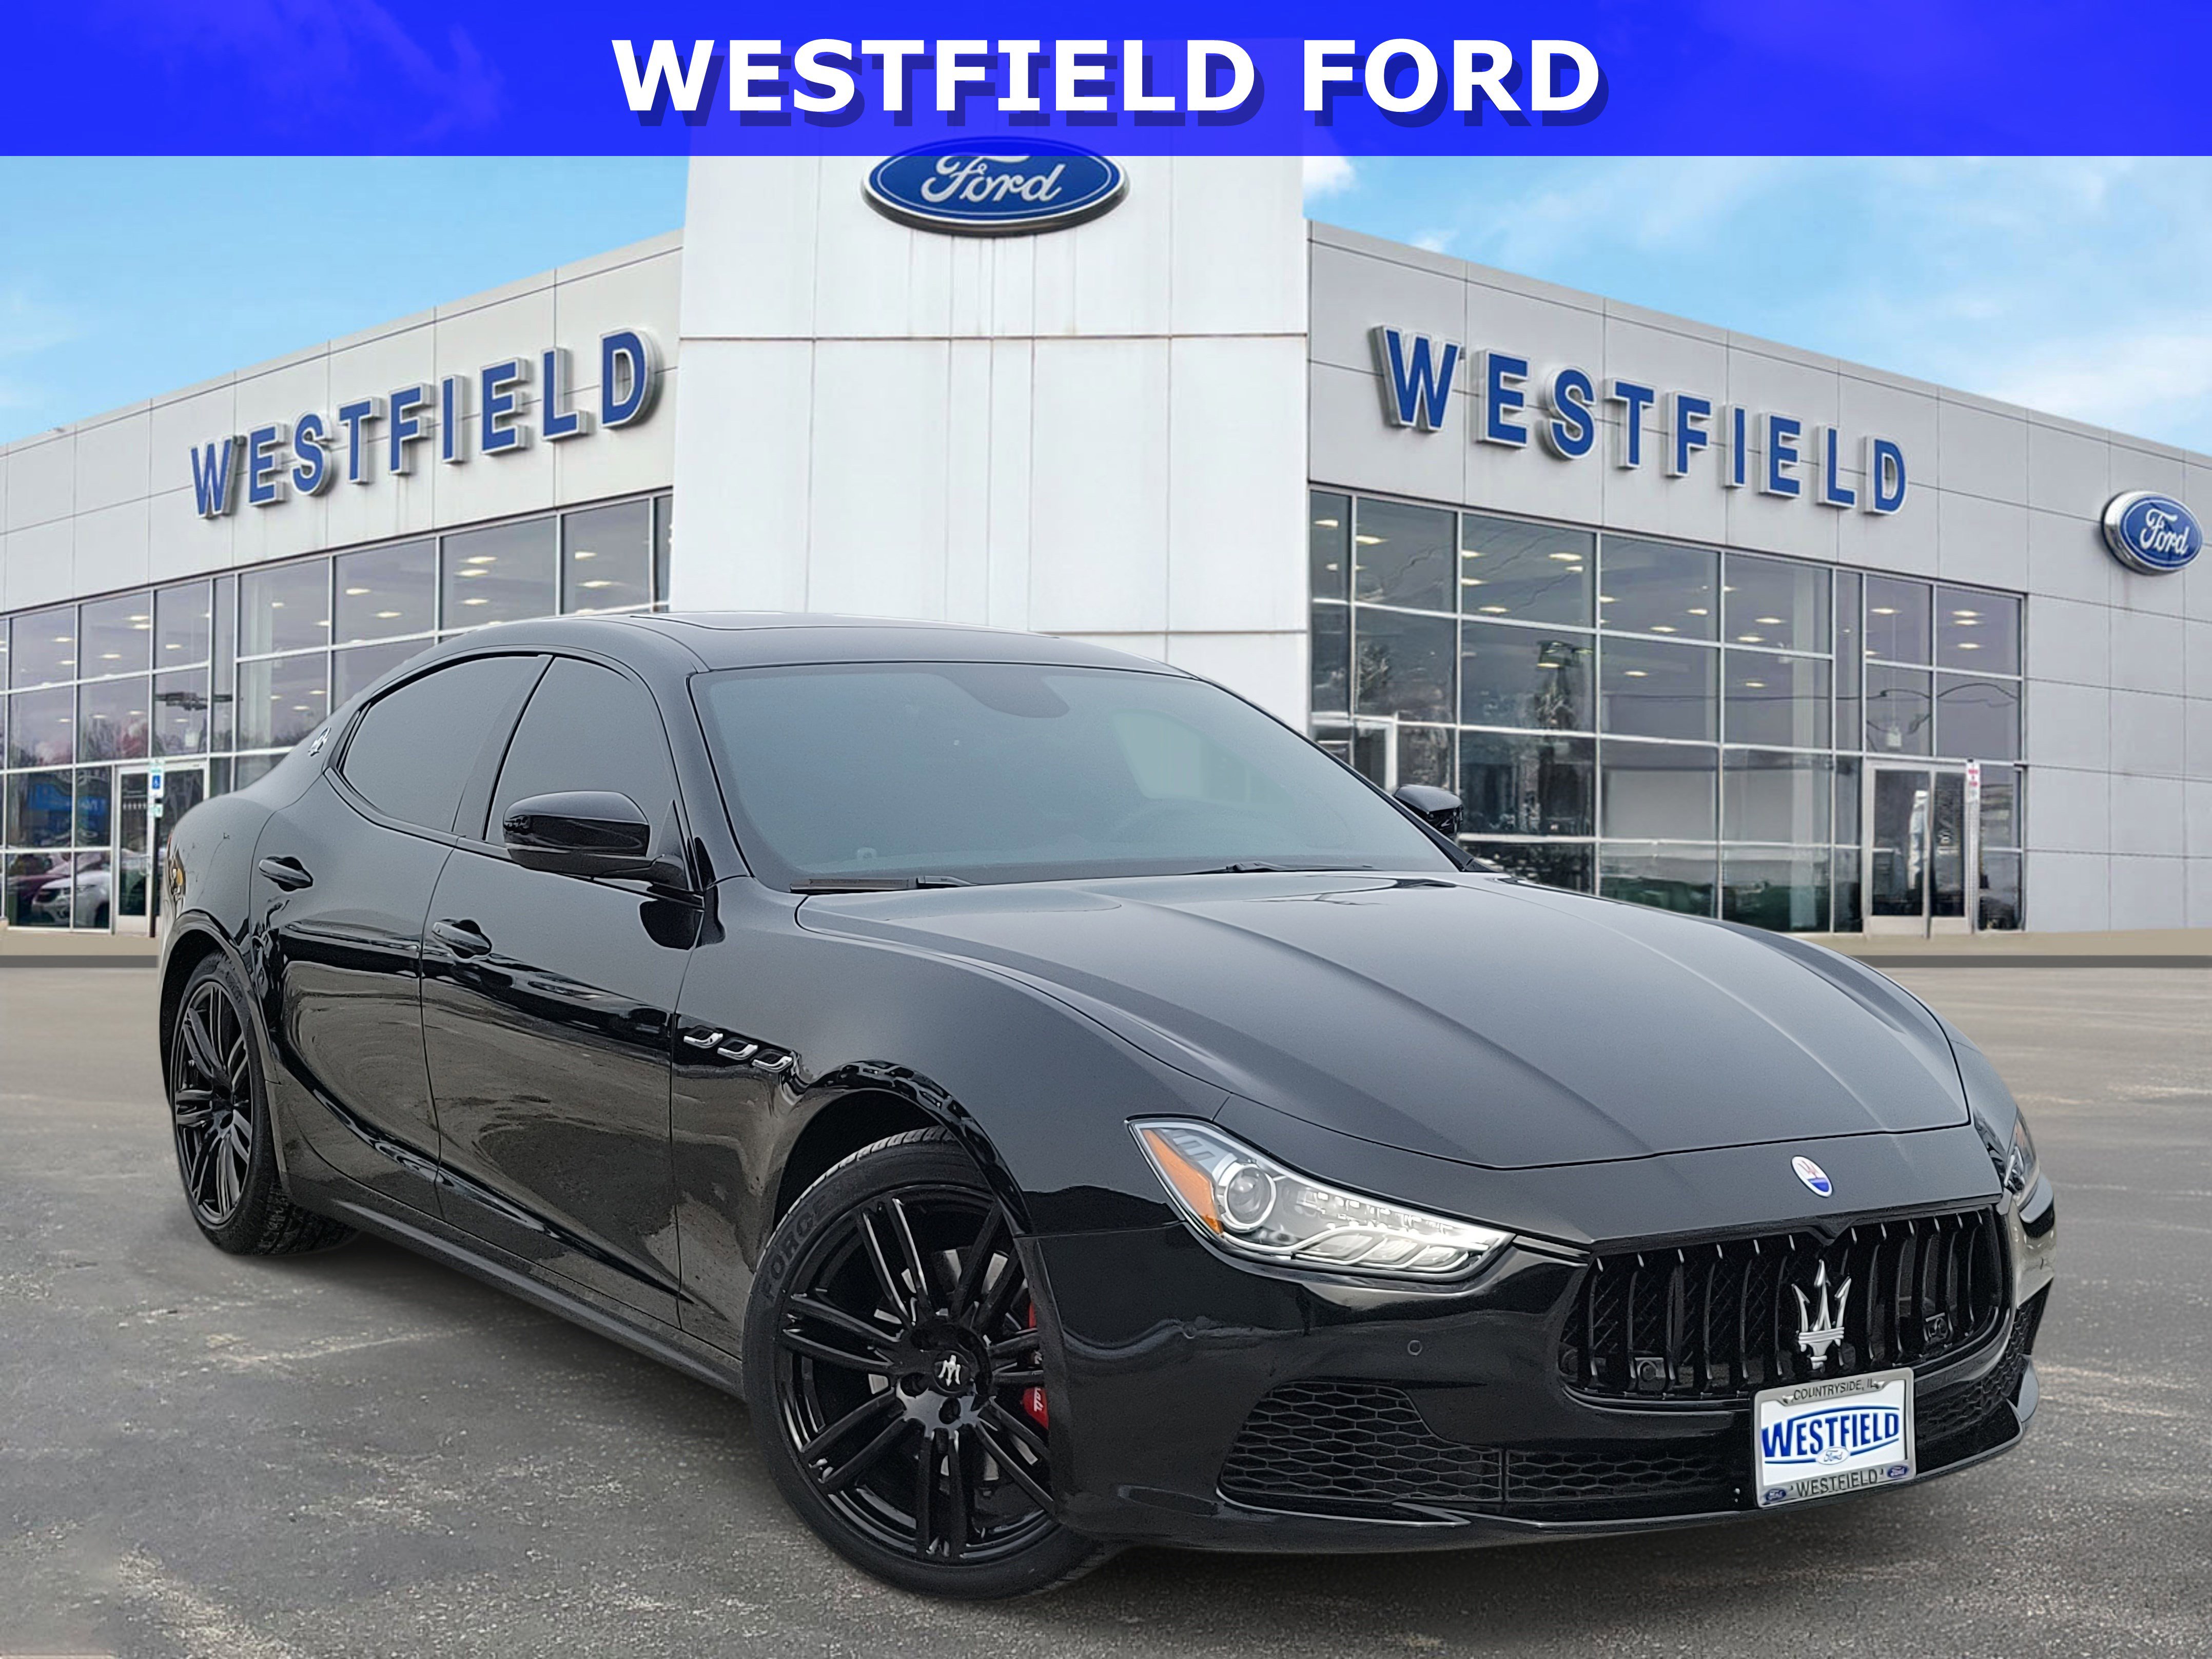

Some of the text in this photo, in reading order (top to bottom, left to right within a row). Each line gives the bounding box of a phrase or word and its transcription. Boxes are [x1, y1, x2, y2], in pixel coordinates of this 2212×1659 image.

[921, 152, 1066, 203] Ford
[190, 328, 663, 519] WESTFIELD
[1373, 325, 1906, 514] WESTFIELD
[2140, 509, 2189, 555] Ford
[1761, 1413, 1899, 1458] WESTFIELD
[1796, 1468, 1878, 1497] WESTFIELD
